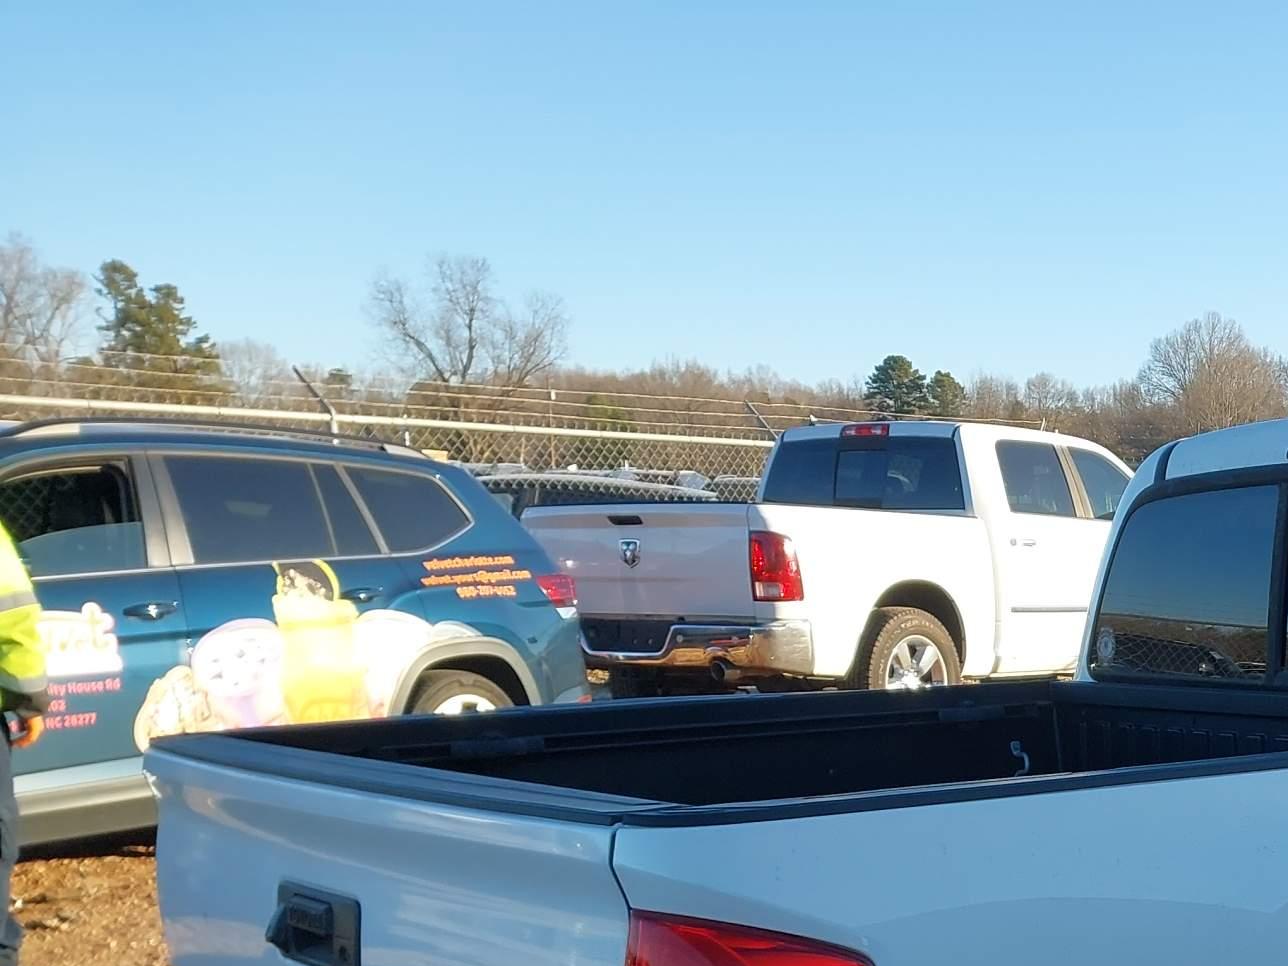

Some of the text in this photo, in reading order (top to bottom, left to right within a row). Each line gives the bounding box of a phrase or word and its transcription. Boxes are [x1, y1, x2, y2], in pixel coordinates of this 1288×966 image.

[68, 680, 104, 694] House
[106, 677, 121, 691] Rd
[45, 715, 63, 729] NC
